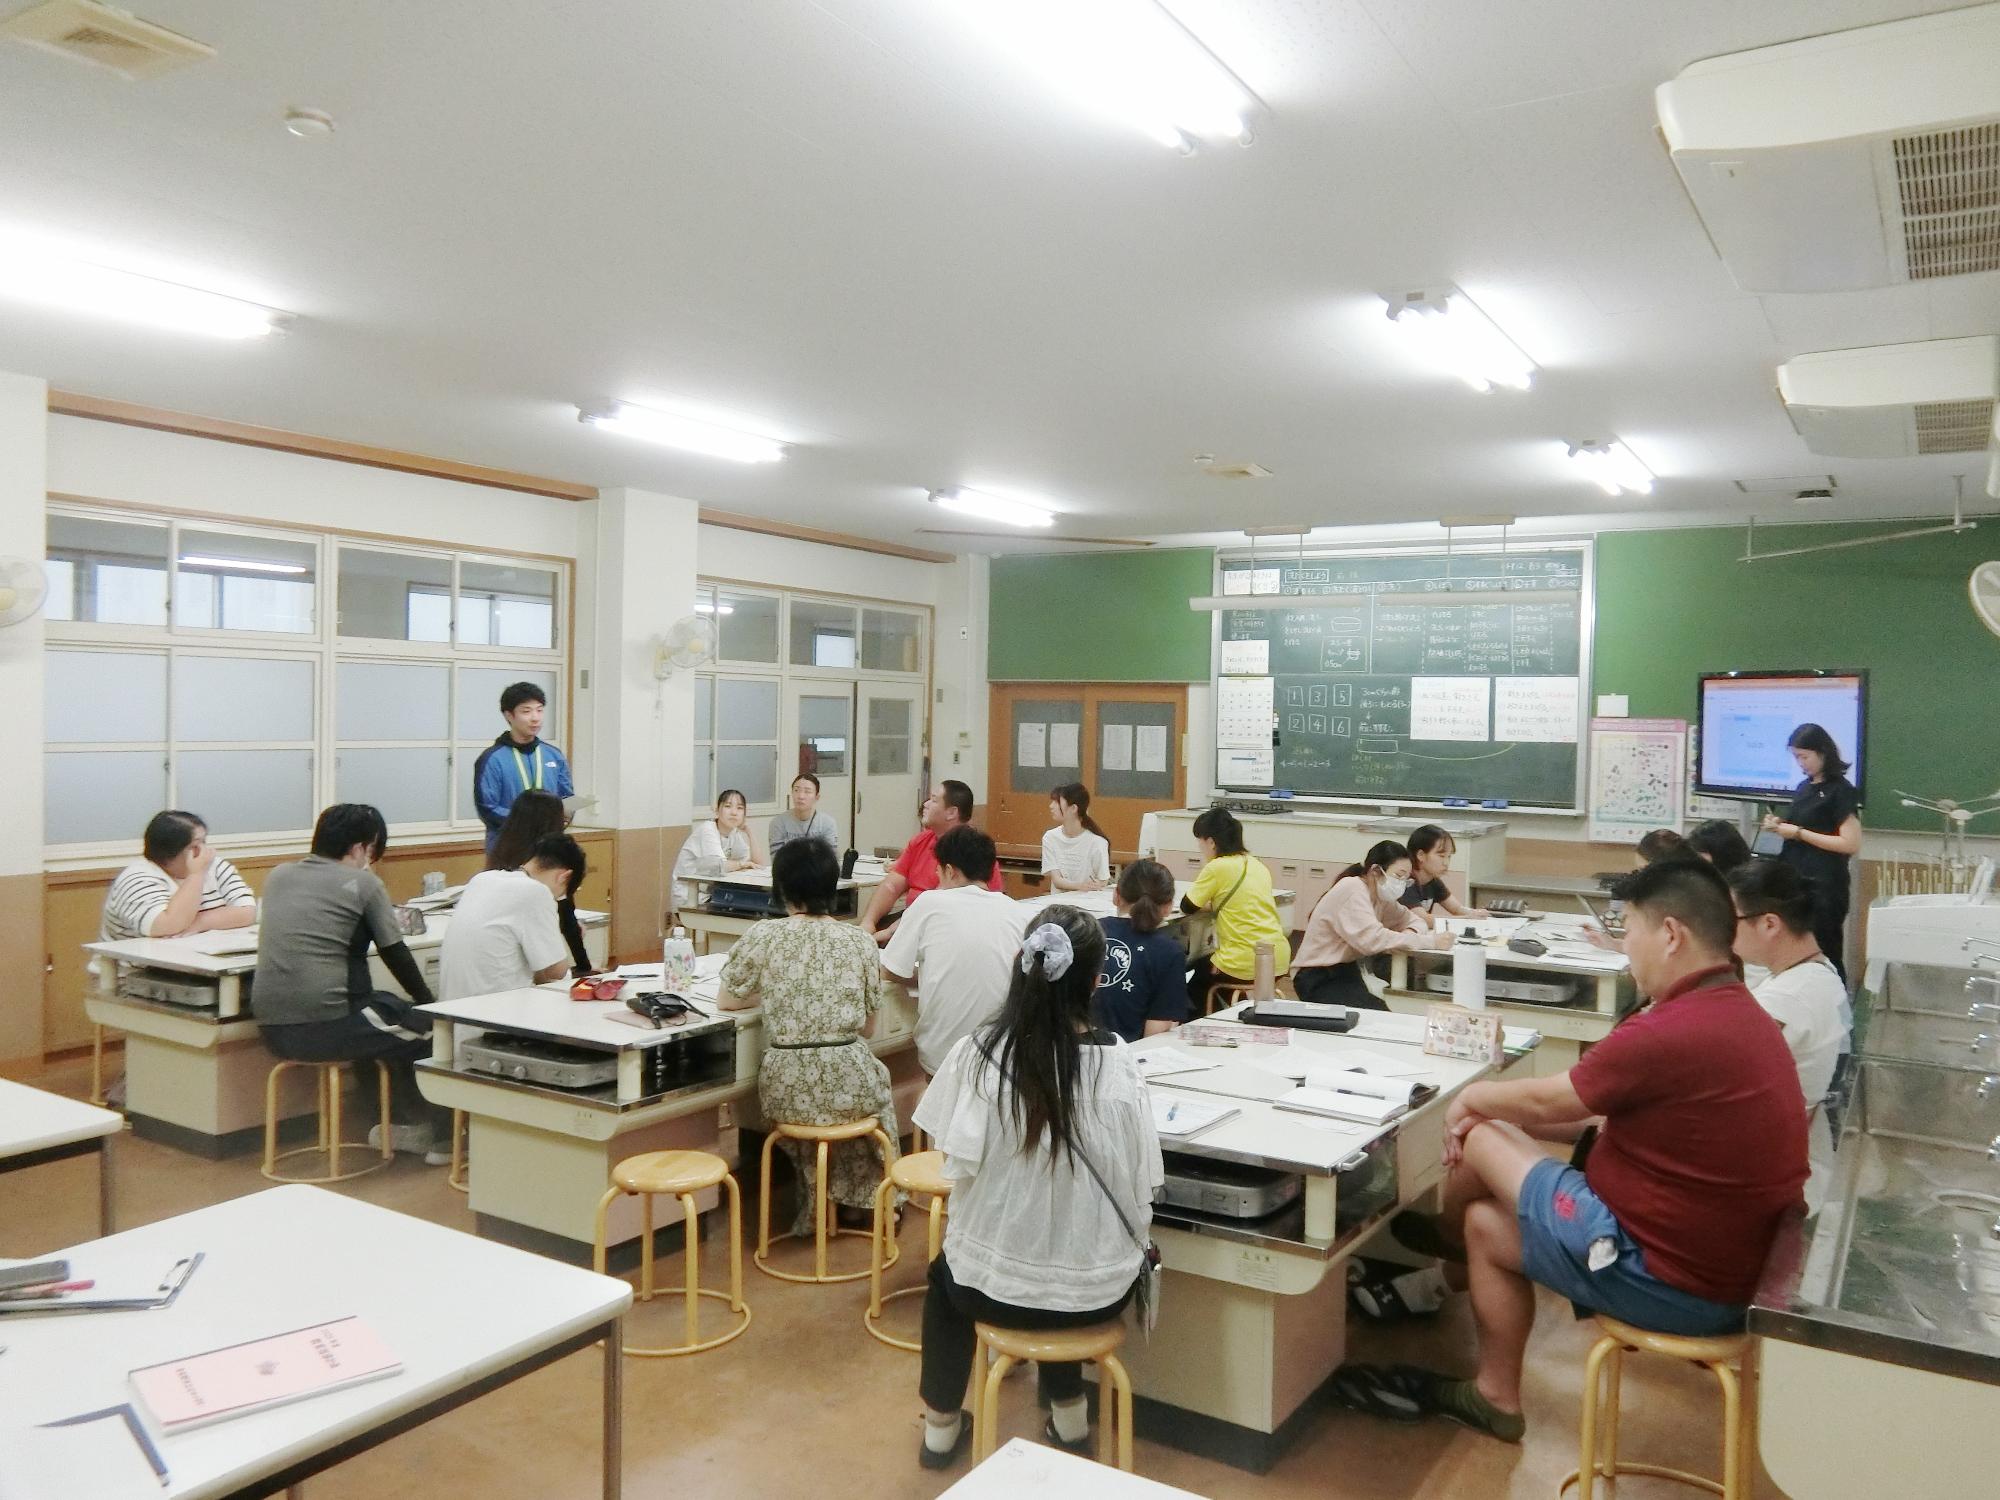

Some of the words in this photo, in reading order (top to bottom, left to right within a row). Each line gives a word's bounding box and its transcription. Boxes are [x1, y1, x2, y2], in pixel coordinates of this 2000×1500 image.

[1313, 690, 1321, 703] 3
[1339, 690, 1346, 703] 5
[1292, 718, 1300, 729] 2
[1313, 719, 1322, 731] 4
[1337, 720, 1345, 734] 6
